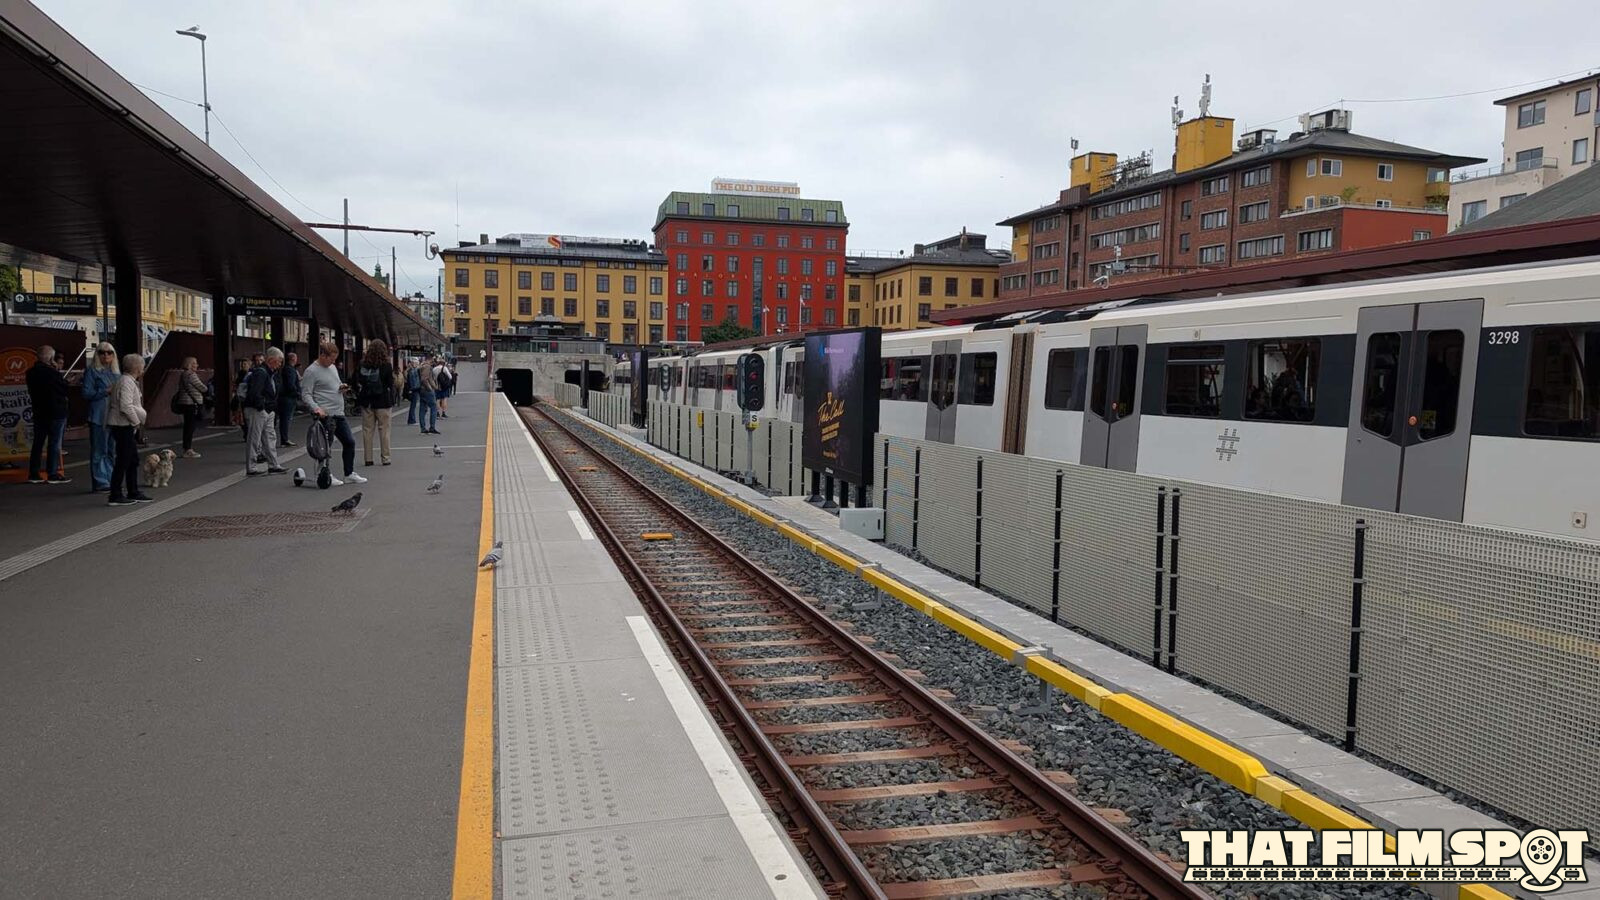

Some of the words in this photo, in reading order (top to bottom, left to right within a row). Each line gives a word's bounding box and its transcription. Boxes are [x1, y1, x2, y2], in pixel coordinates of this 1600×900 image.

[715, 183, 733, 191] THE
[735, 184, 753, 192] OLD
[756, 185, 780, 194] IRISH
[36, 295, 63, 305] Utgang
[65, 296, 78, 304] Exit
[246, 298, 271, 307] Utgang
[1488, 331, 1520, 345] 3298
[752, 415, 758, 423] S
